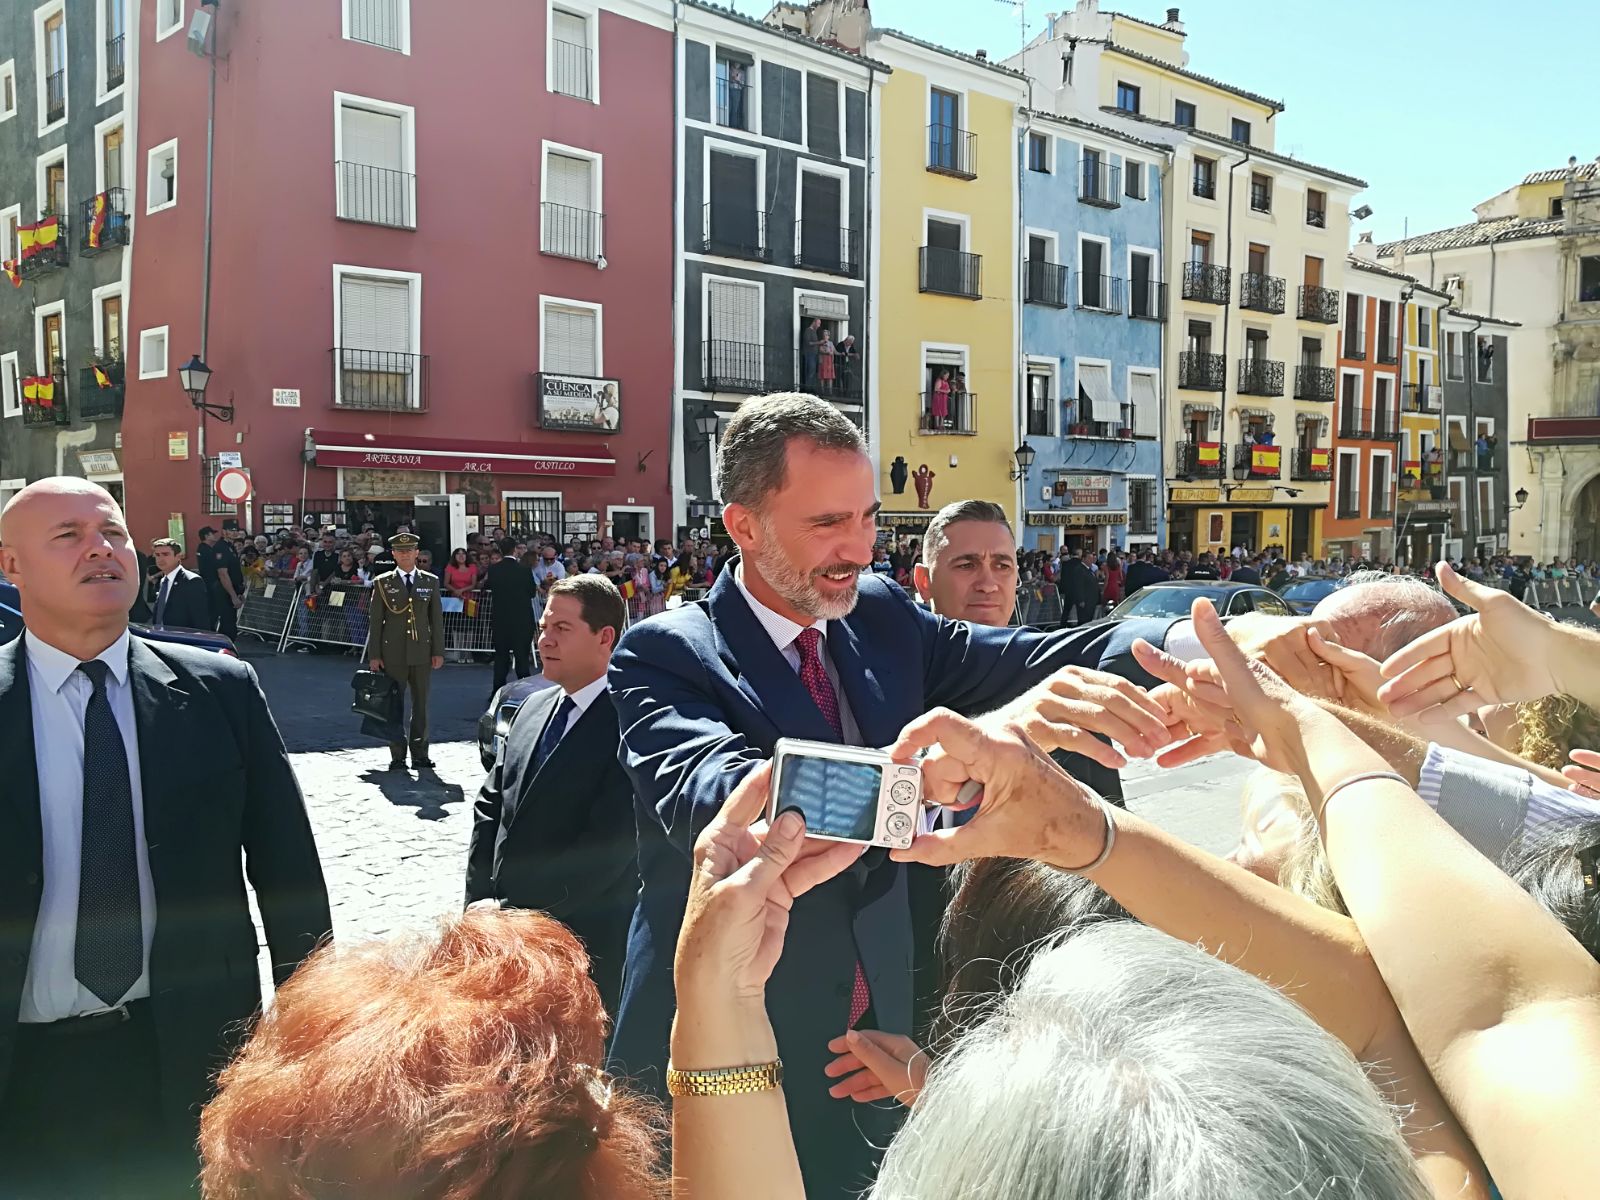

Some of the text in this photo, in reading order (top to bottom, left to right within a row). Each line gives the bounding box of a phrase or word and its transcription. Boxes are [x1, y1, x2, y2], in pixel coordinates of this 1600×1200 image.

[546, 381, 591, 393] CUENCA
[363, 453, 422, 464] ARTESANIA
[534, 461, 576, 470] CASTILLO
[1084, 514, 1124, 524] REGALOS
